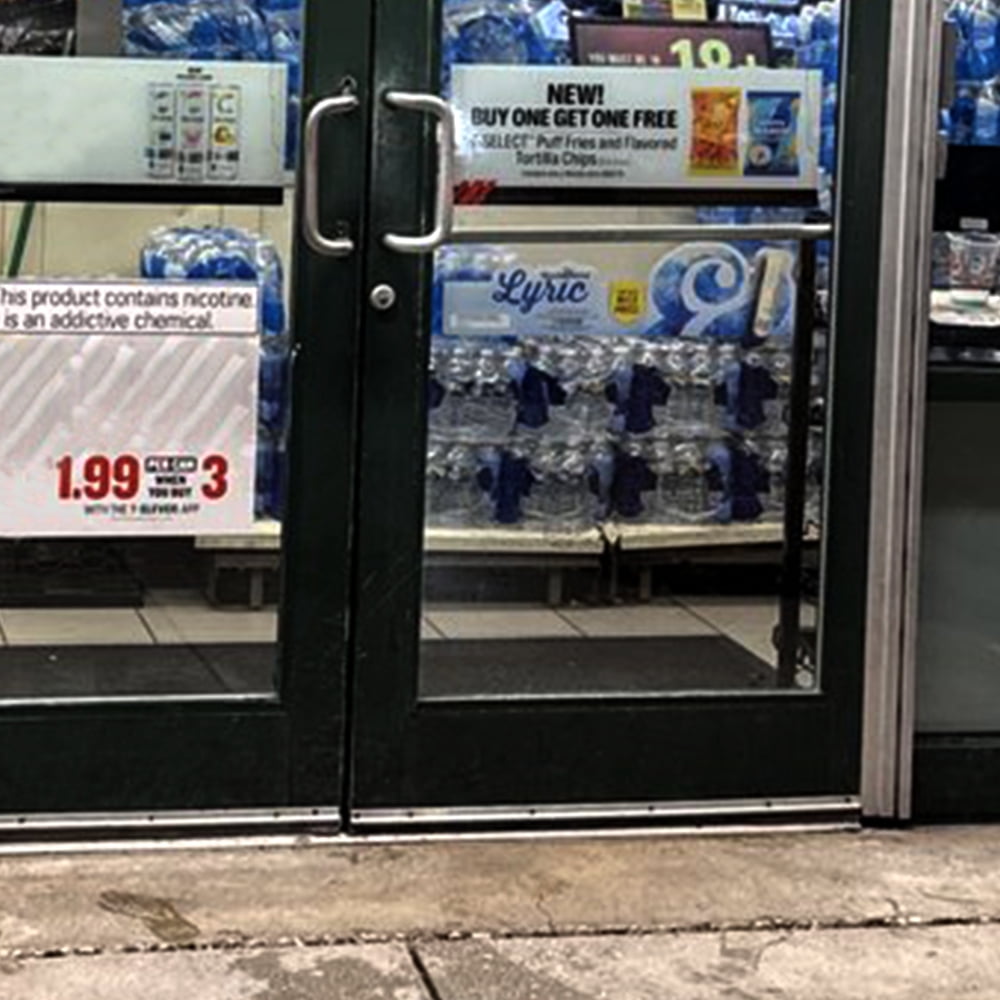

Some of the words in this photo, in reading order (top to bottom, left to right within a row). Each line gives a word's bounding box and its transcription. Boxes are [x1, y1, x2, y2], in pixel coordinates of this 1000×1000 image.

[547, 83, 605, 105] NEW!
[471, 107, 510, 127] BUY
[512, 108, 550, 127] ONE
[553, 108, 589, 128] GET
[591, 109, 631, 128] ONE
[633, 109, 679, 129] FREE
[565, 135, 596, 150] Fries
[599, 135, 623, 150] and
[515, 151, 559, 166] Tortilla
[561, 152, 598, 168] Chips
[31, 287, 101, 310] product
[105, 289, 179, 308] contains
[492, 268, 588, 314] Lyric
[4, 309, 19, 328] is
[23, 312, 46, 328] an
[50, 310, 130, 330] addictive
[55, 454, 141, 500] 1.99
[201, 454, 228, 500] 3
